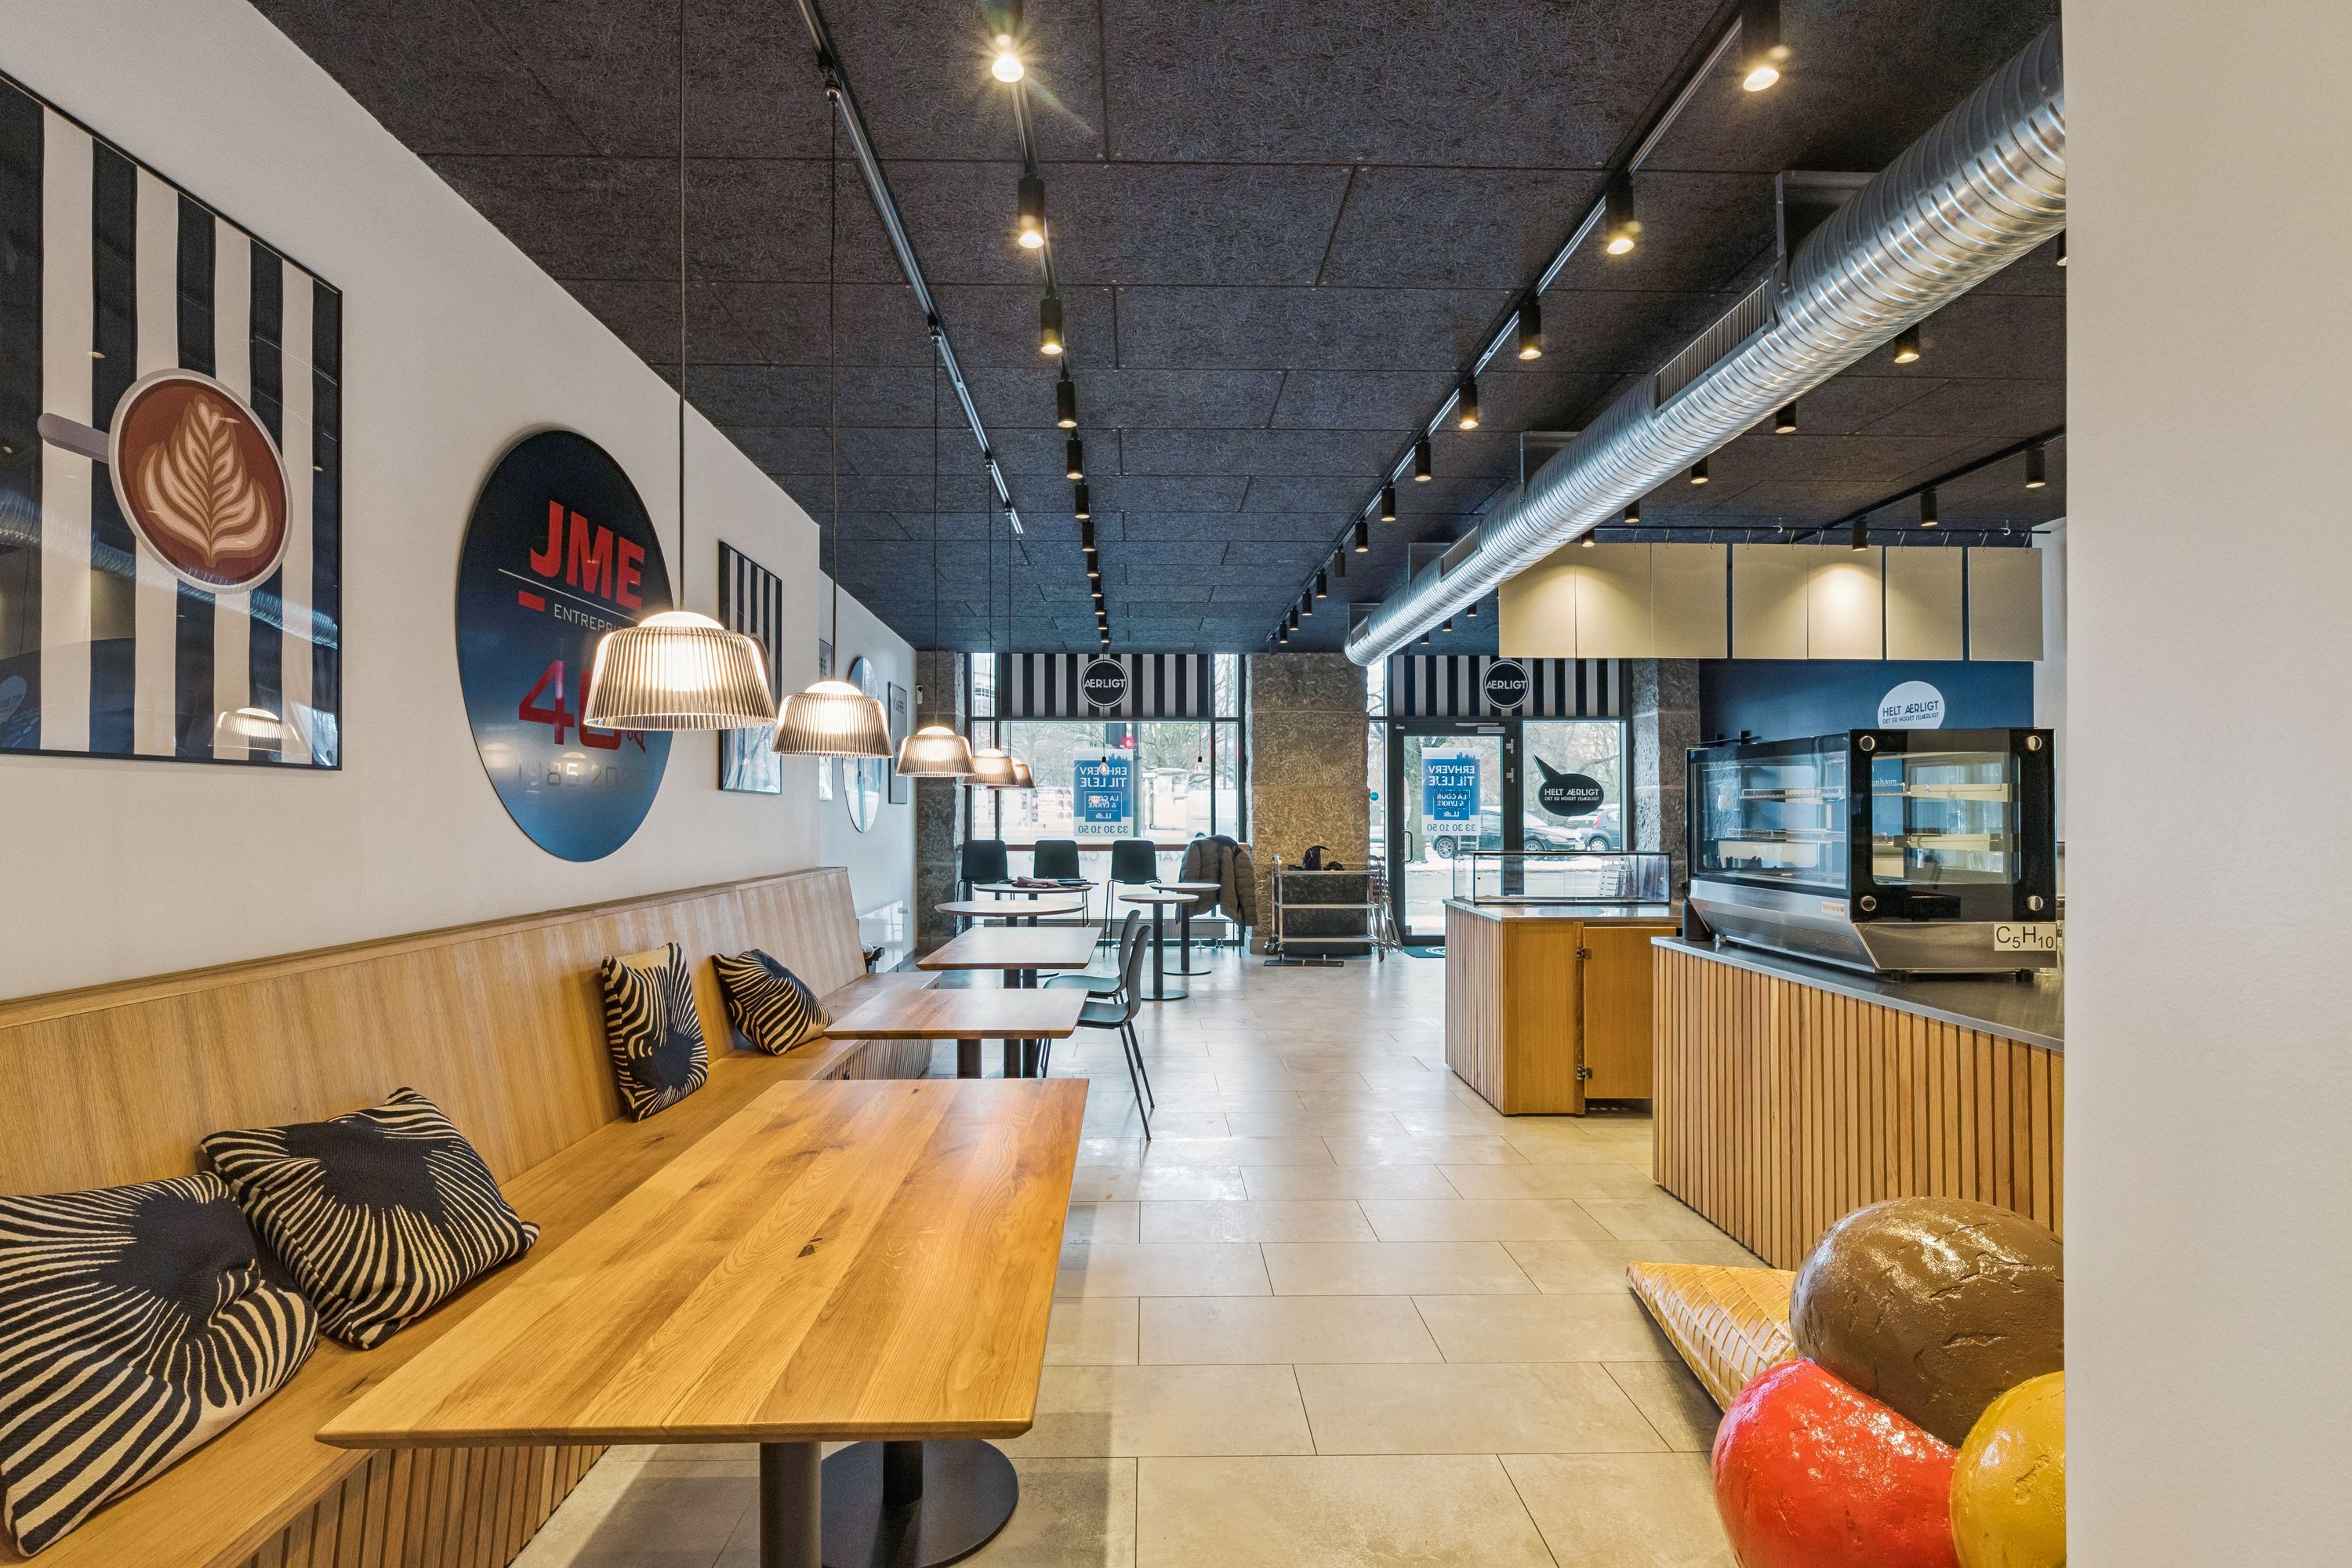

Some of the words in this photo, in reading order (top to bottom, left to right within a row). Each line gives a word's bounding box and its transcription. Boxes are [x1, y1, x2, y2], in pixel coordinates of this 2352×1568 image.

[530, 499, 645, 611] JME
[1882, 705, 1902, 717] HELT
[1904, 700, 1940, 715] ÆRLIGT
